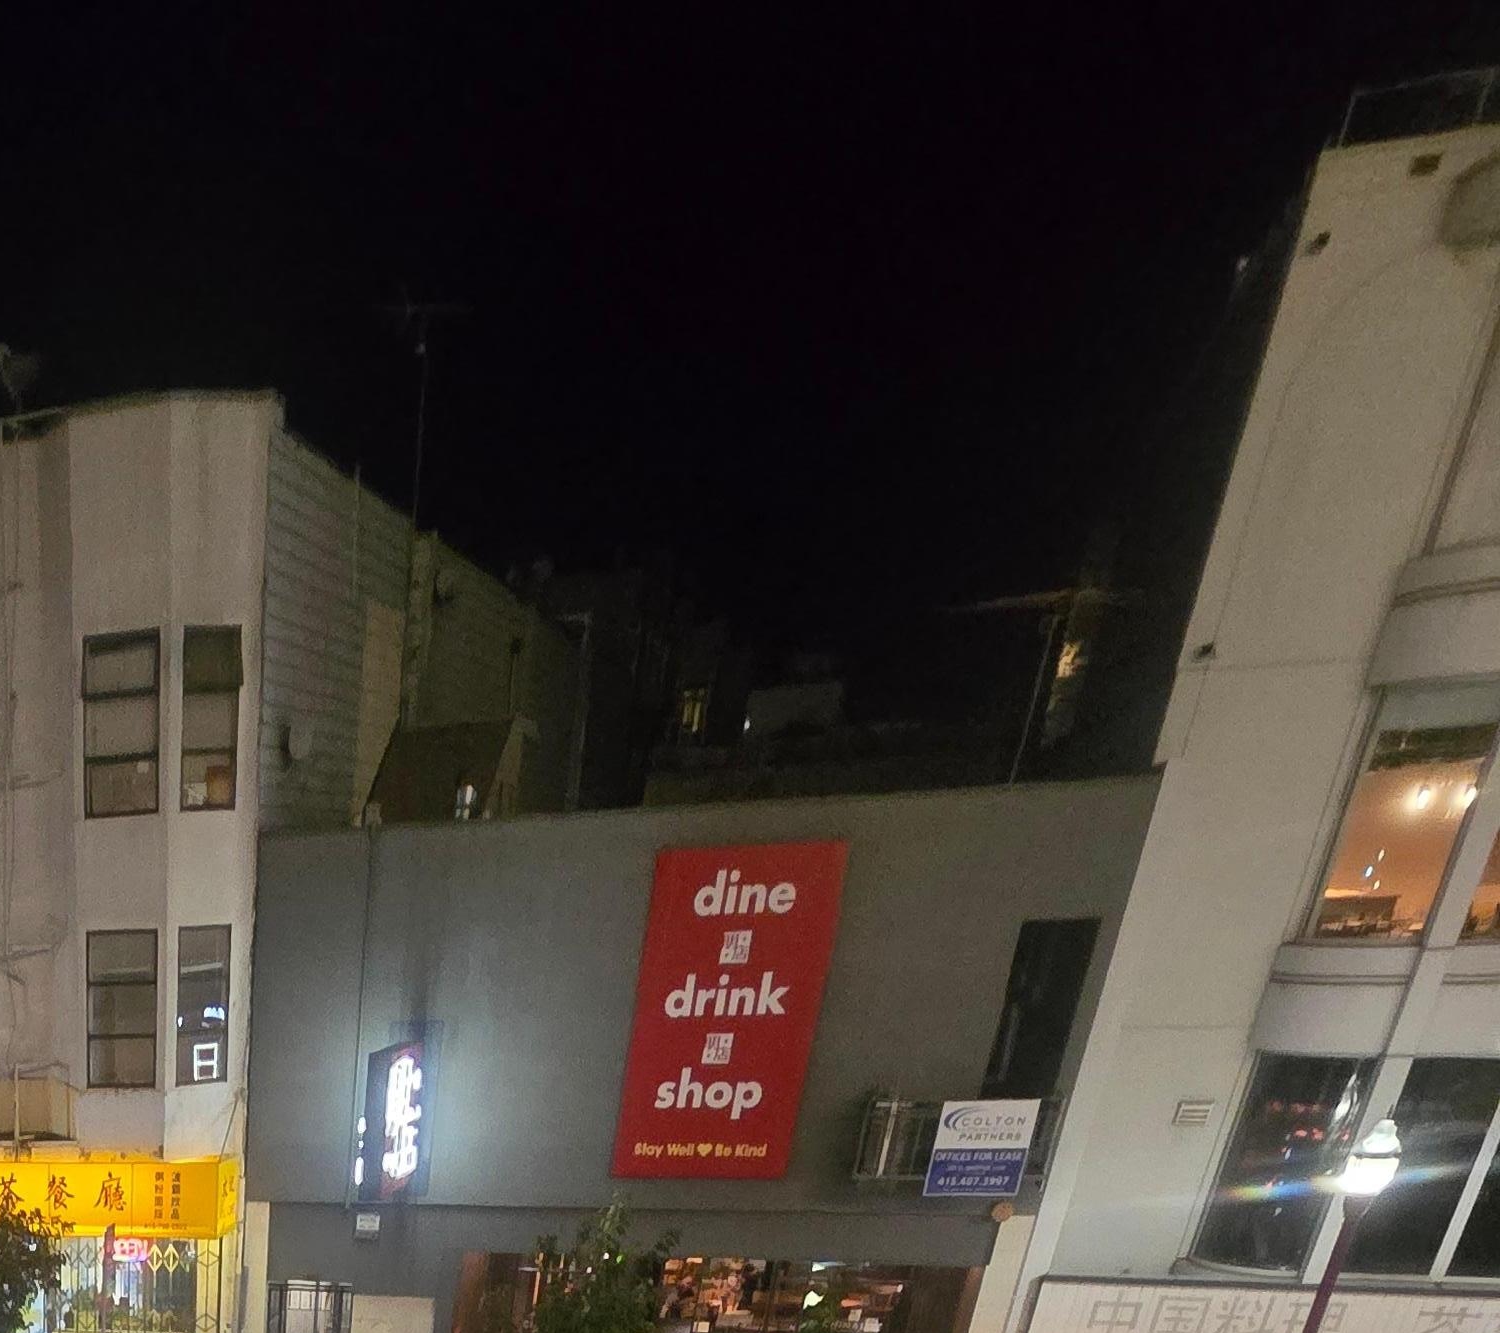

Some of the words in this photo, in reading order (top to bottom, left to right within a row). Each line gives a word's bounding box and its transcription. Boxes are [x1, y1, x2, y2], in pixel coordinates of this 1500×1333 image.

[693, 868, 797, 917] dine
[664, 971, 790, 1019] drink
[654, 1066, 763, 1120] shop
[957, 1131, 1023, 1142] PARTNERS
[961, 1116, 1027, 1127] COLTON
[634, 1142, 664, 1158] Stay
[667, 1142, 695, 1158] Well
[735, 1142, 768, 1158] Kind
